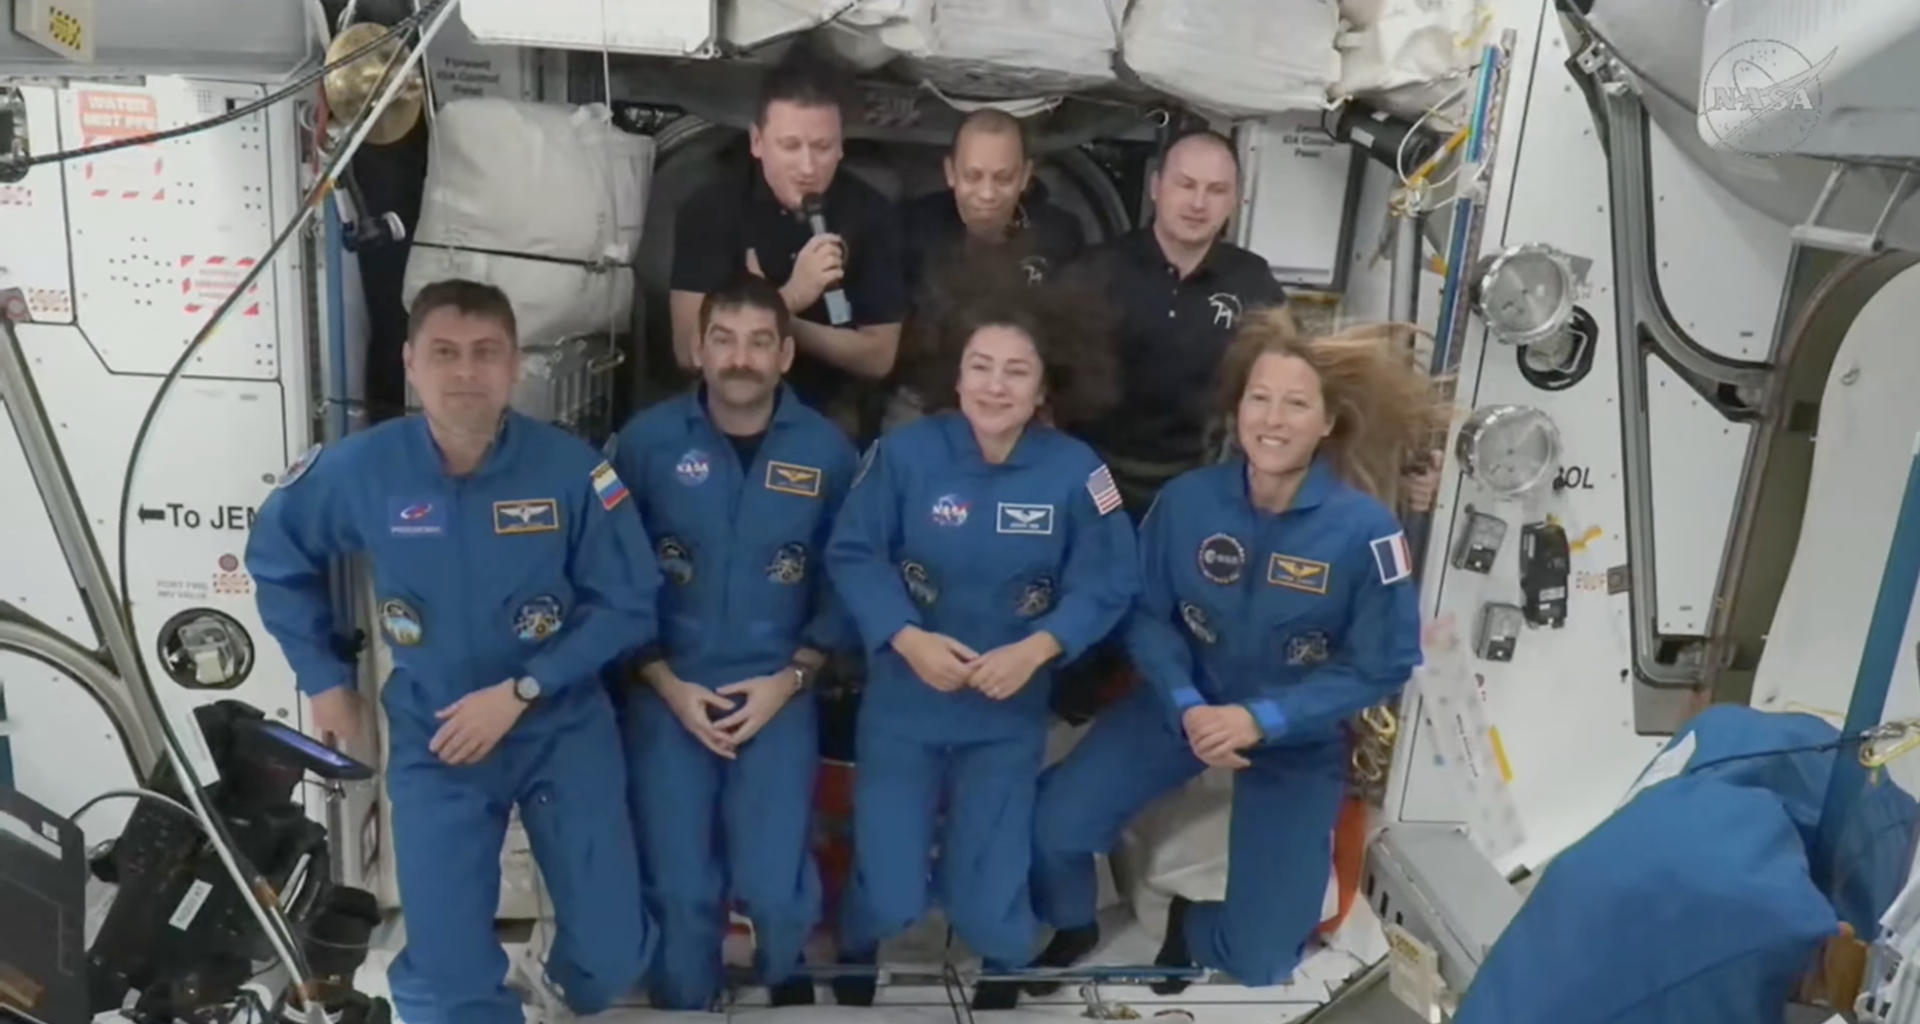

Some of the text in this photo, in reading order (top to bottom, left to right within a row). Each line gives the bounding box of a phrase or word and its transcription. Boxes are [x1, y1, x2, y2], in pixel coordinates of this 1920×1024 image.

[675, 463, 709, 474] NASA
[166, 503, 200, 528] To
[932, 504, 968, 519] NASA
